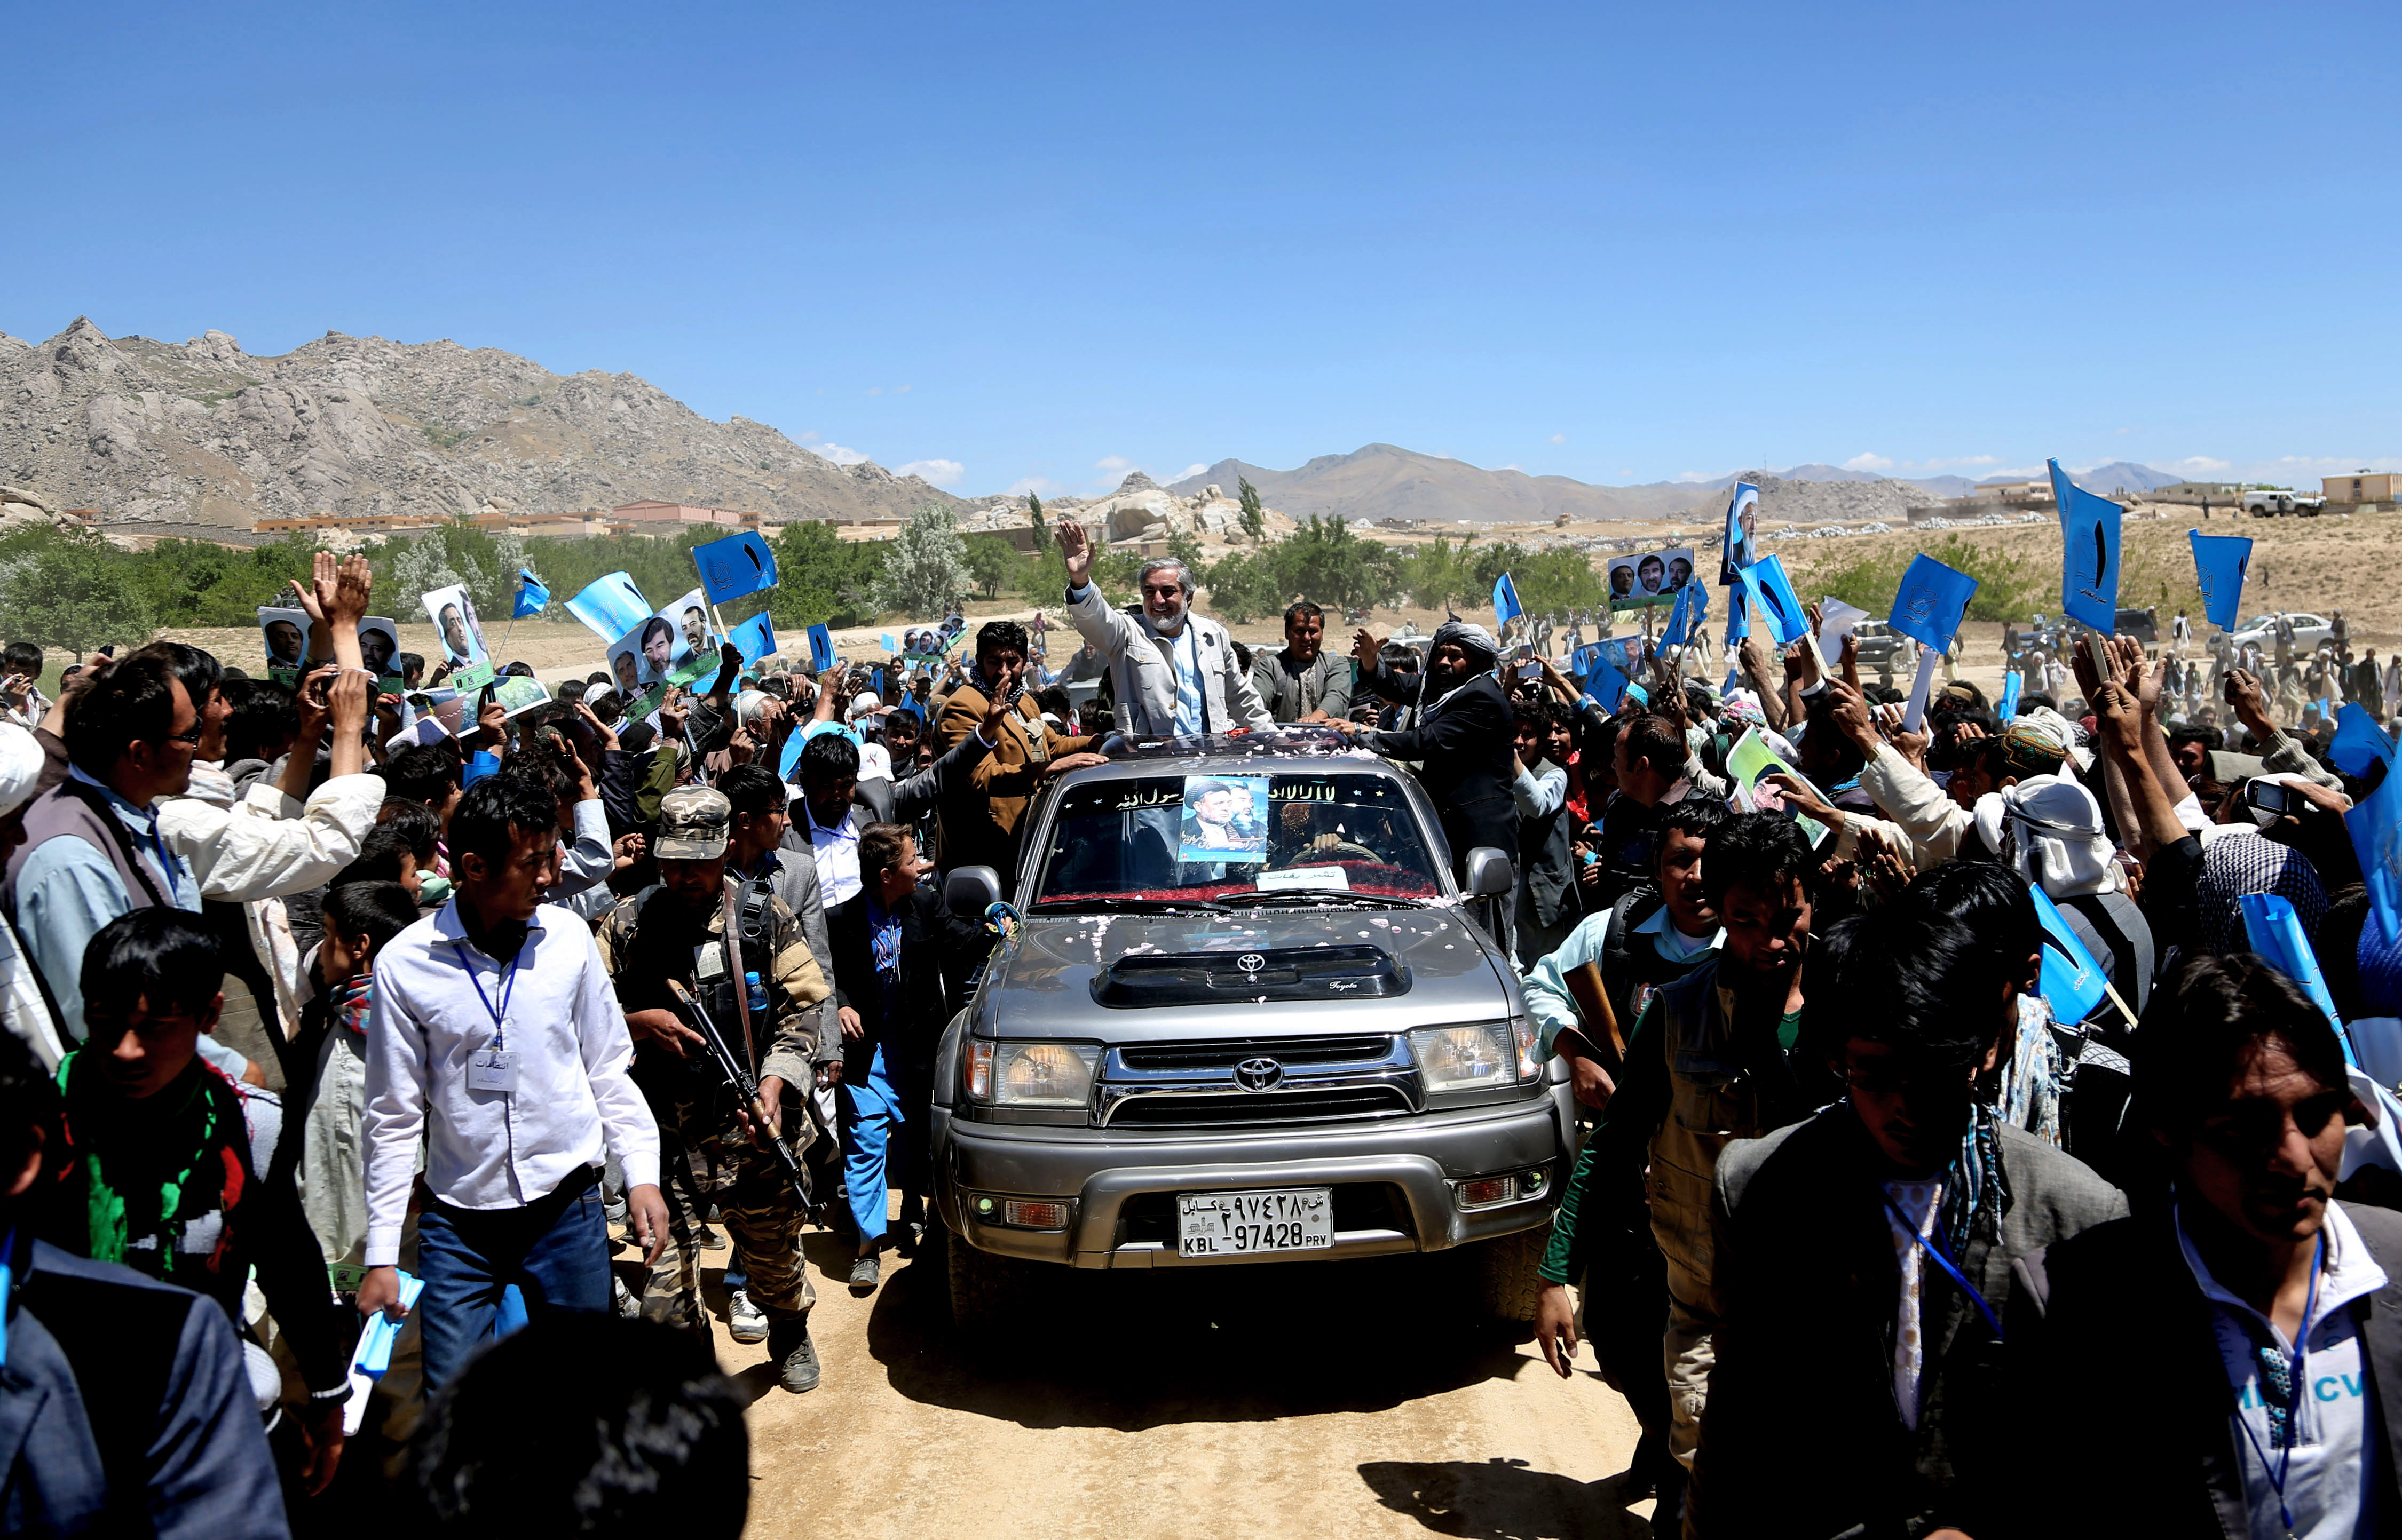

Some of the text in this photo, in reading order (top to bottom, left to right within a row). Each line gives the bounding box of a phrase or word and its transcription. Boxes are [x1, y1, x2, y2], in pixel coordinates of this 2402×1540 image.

[1329, 981, 1357, 991] Toyota
[1184, 1221, 1326, 1253] KBL 97428 PRV
